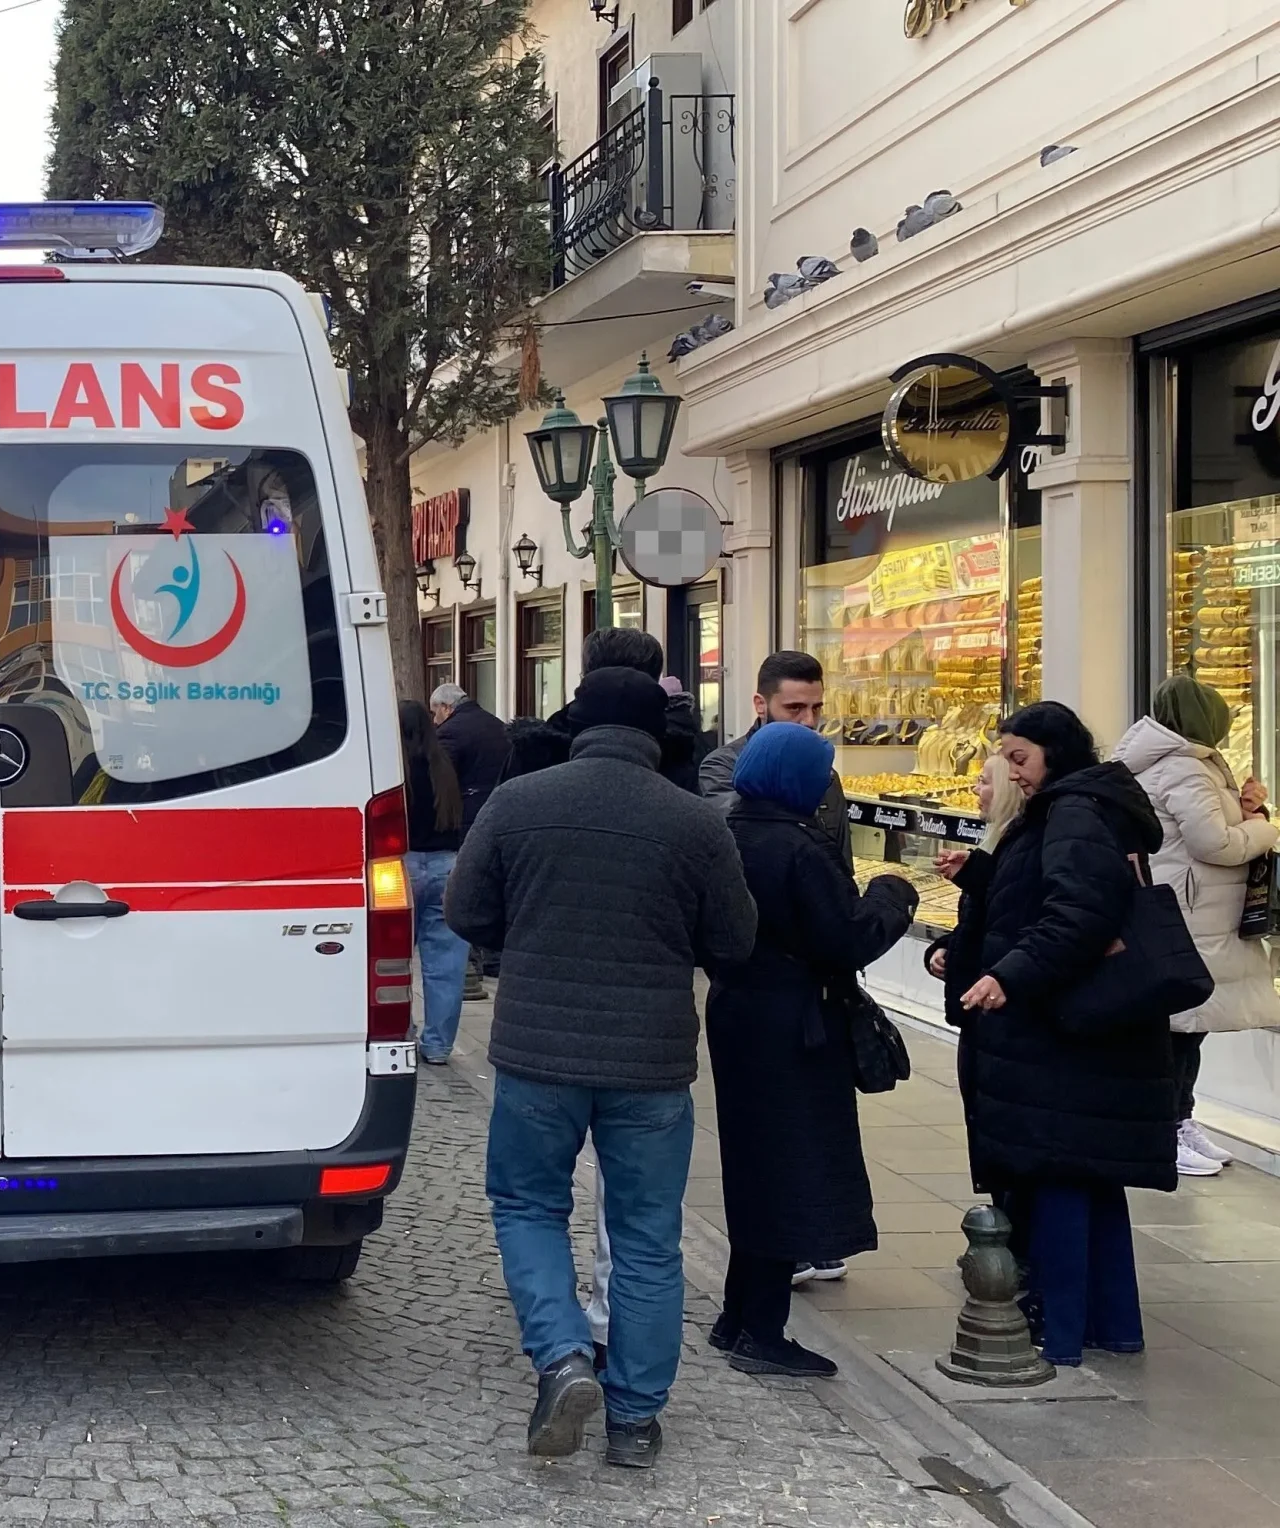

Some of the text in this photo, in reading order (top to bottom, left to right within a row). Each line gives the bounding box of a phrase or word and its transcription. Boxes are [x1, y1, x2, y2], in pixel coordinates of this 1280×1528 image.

[81, 681, 281, 706] T.C. Sağlık Bakanlığı
